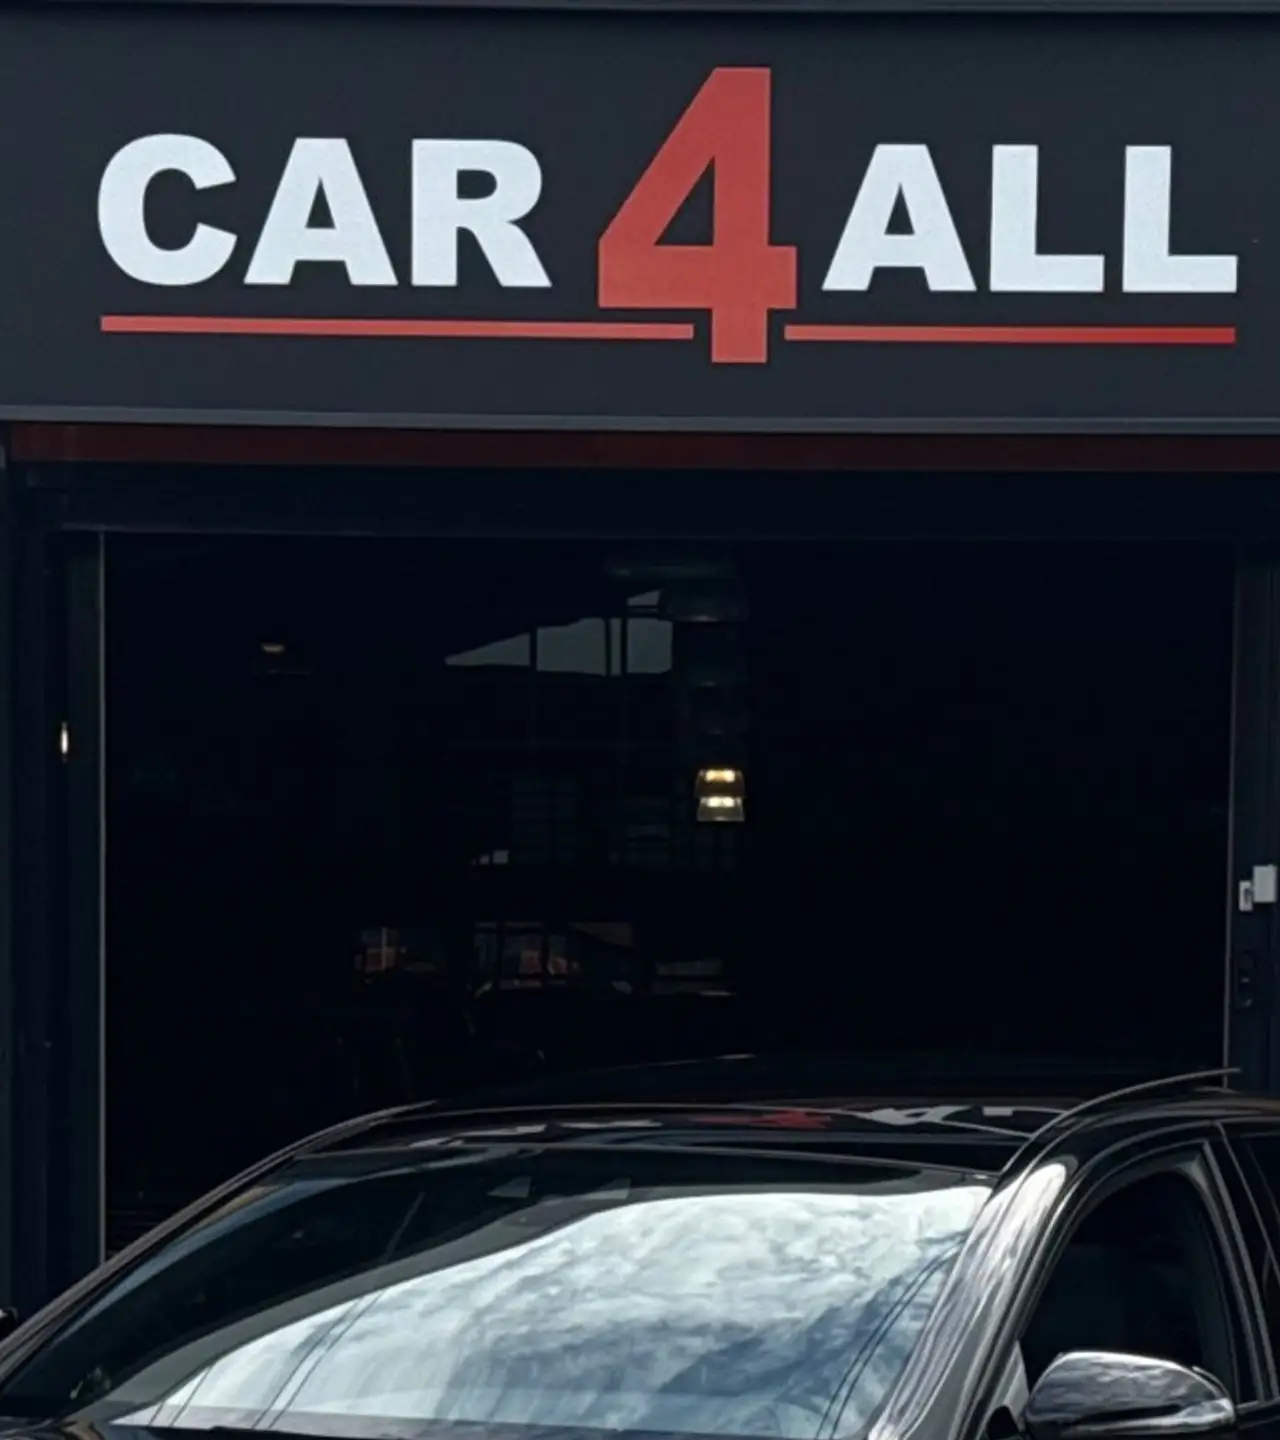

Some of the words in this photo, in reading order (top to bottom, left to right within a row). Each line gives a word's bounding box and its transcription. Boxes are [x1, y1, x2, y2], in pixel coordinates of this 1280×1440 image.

[96, 132, 553, 288] CAR
[597, 65, 798, 364] 4
[821, 142, 1239, 293] ALL
